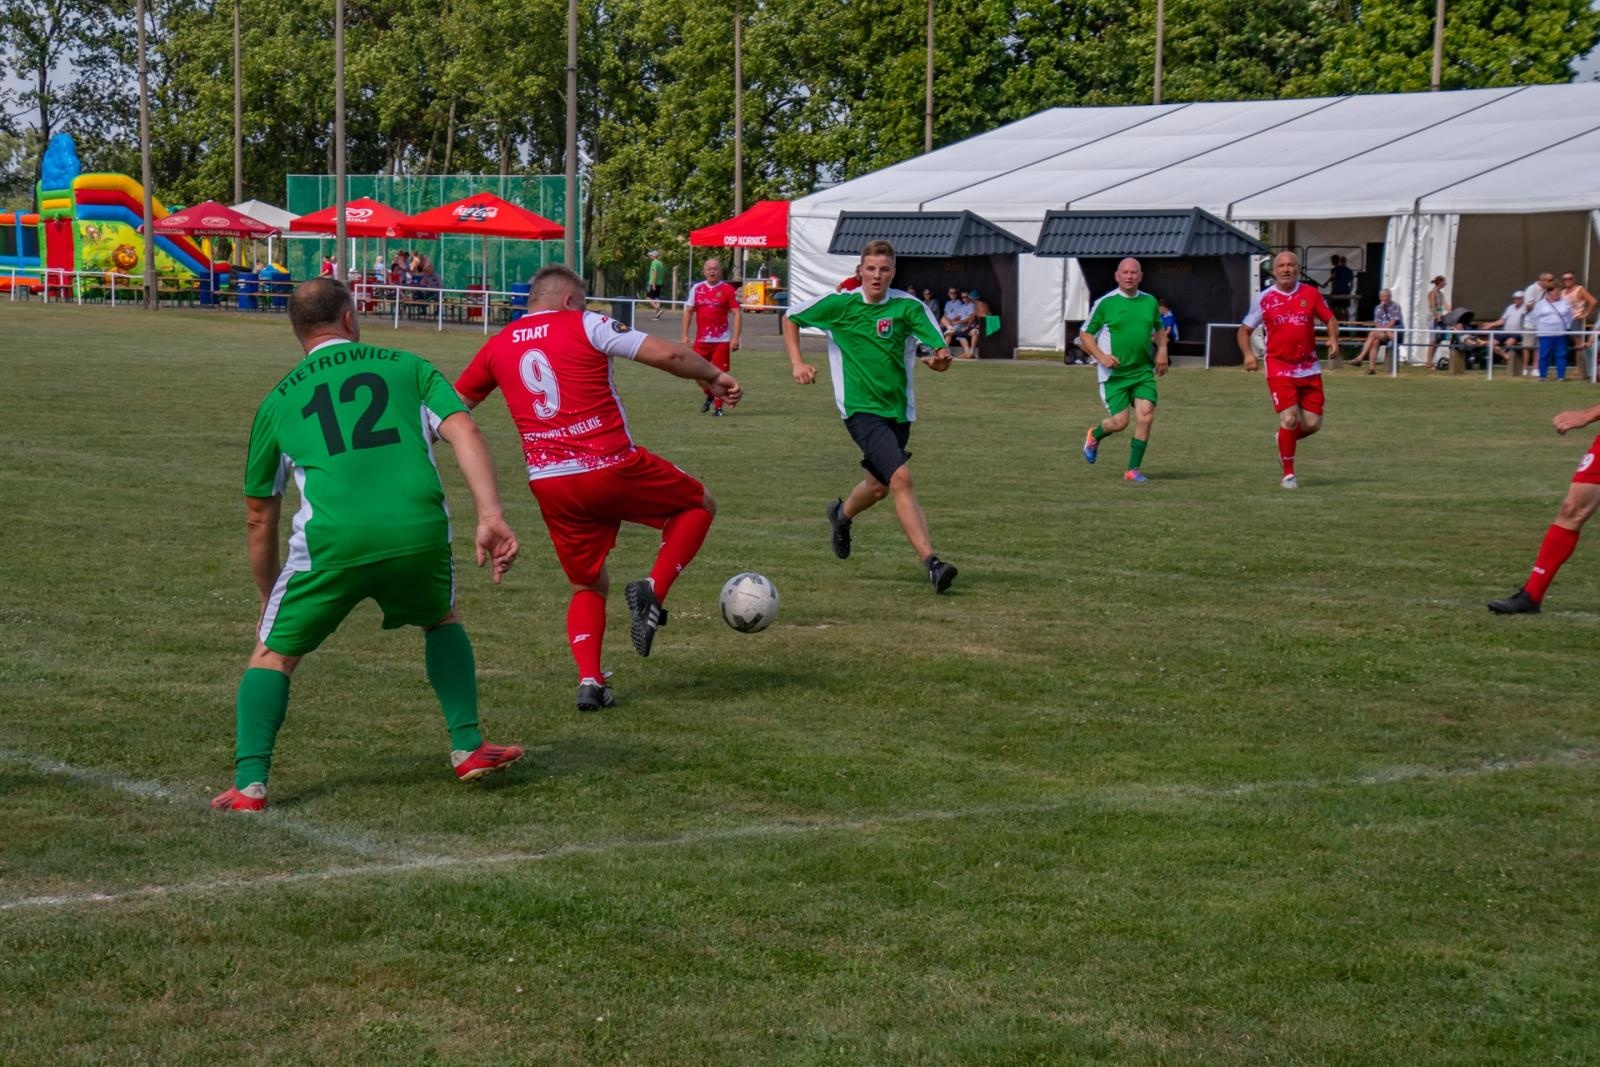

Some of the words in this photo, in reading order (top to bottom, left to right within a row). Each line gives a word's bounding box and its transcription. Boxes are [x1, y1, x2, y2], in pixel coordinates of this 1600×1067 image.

[723, 235, 738, 246] OSP
[738, 235, 768, 246] KORNICE
[511, 323, 550, 343] START
[277, 345, 402, 397] PIETROWICE
[518, 348, 561, 420] 9
[300, 371, 401, 458] 12
[567, 415, 603, 436] WIELKIE
